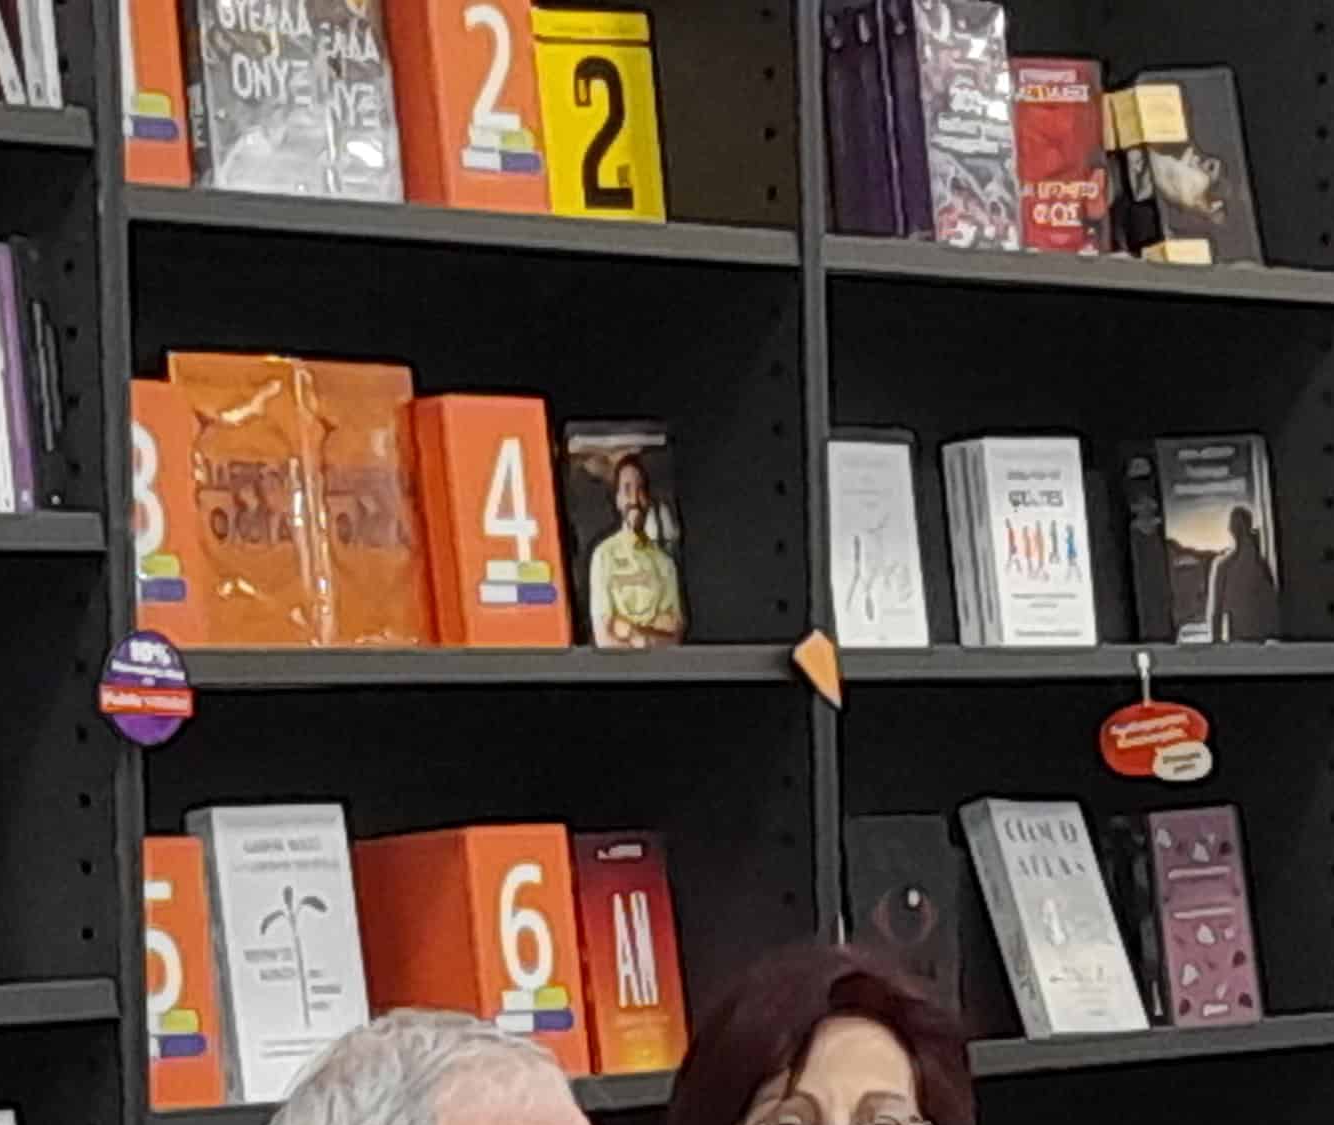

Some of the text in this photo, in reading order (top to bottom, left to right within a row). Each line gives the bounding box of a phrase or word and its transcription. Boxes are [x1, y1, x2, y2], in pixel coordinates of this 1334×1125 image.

[464, 4, 521, 128] 2
[573, 55, 634, 210] 2
[483, 436, 539, 563] 4
[144, 879, 184, 1008] 5
[499, 862, 554, 989] 6
